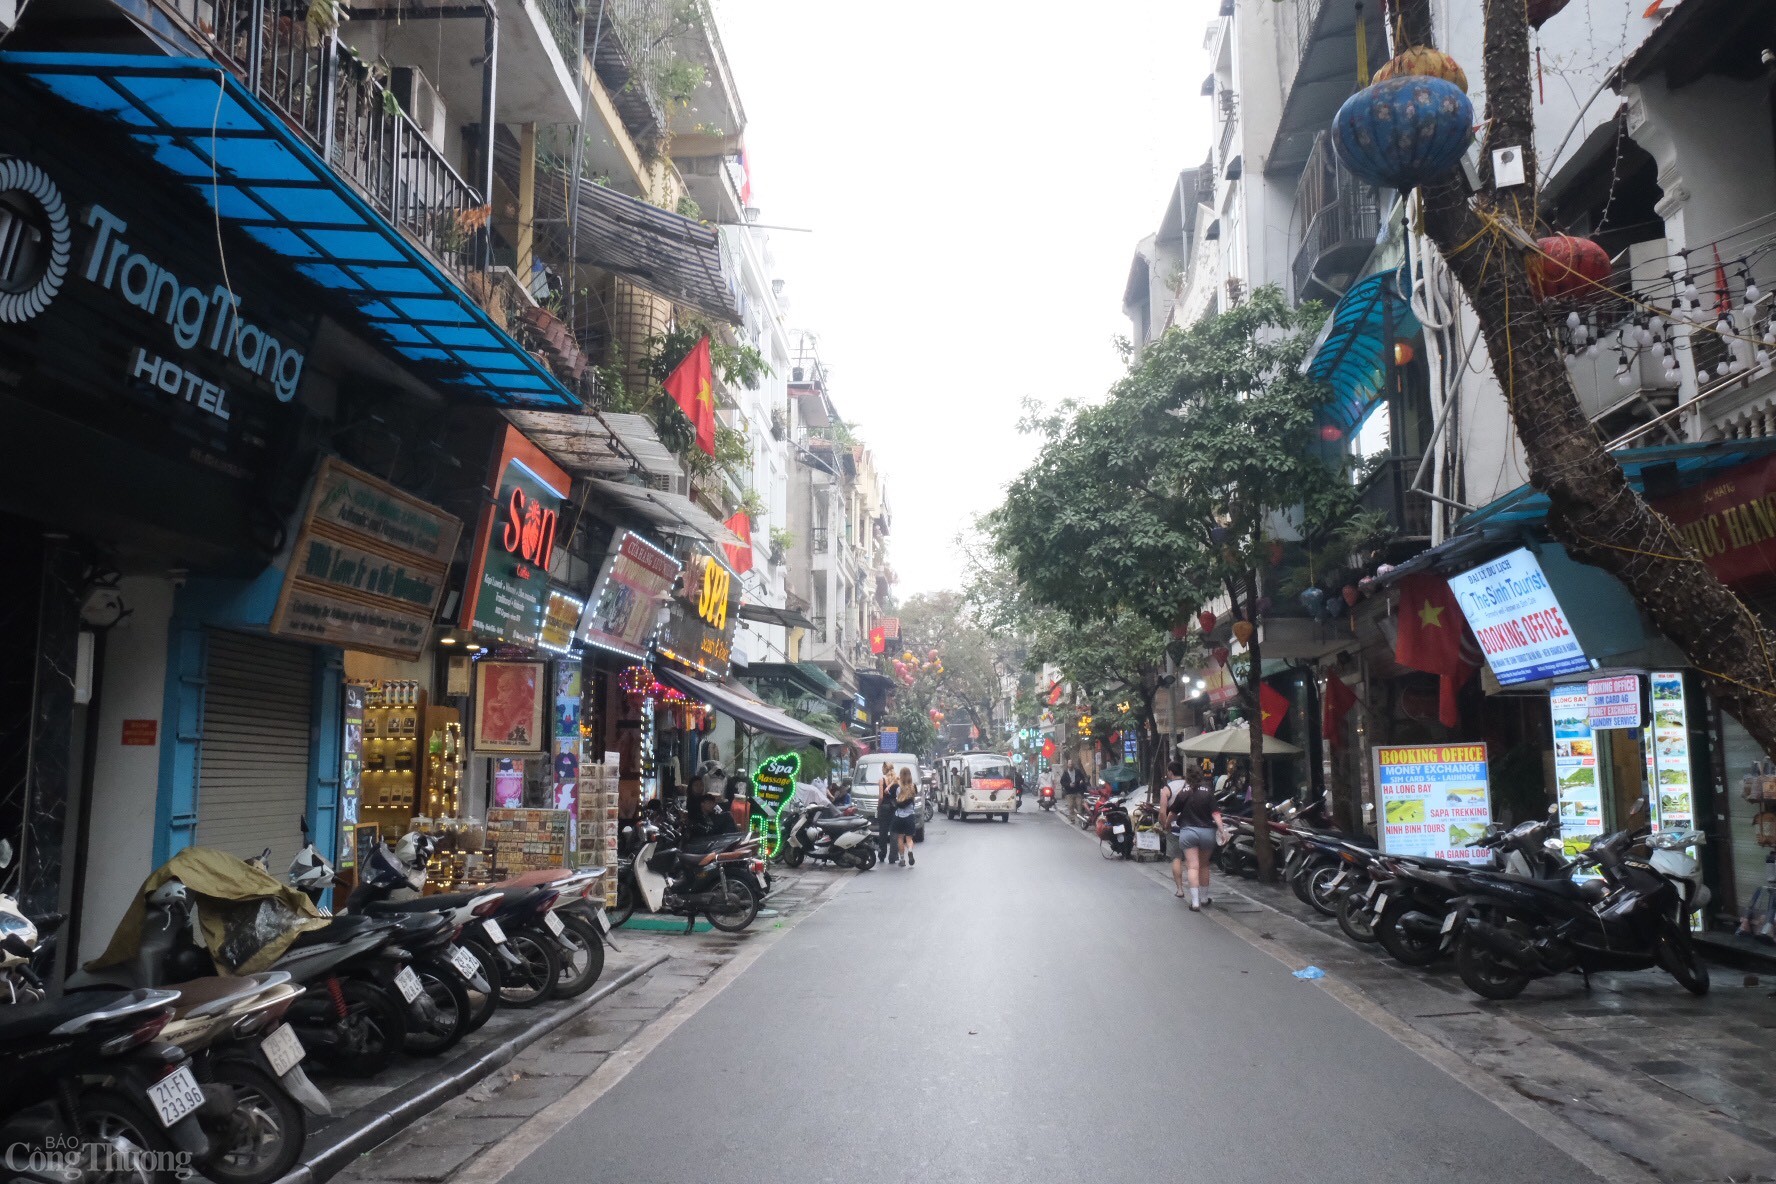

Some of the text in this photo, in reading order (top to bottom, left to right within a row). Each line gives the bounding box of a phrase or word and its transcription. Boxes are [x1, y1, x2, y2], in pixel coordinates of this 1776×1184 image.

[133, 347, 231, 421] HOTEL
[699, 556, 730, 630] SPA
[1477, 606, 1569, 655] BOOKING OFFICE
[1613, 678, 1637, 692] OFFICE
[1594, 696, 1606, 706] SIM
[1606, 695, 1620, 705] CARD
[1621, 694, 1630, 703] 4G
[1589, 704, 1637, 717] MONEY EXCHANGE
[1590, 715, 1637, 728] LAUNDRY SERVICE
[1381, 746, 1484, 765] BOOKING OFFICE
[768, 760, 794, 775] Spa
[1385, 763, 1481, 776] MONEY EXCHANGE
[758, 773, 791, 786] Massage
[1390, 775, 1405, 784] SIM
[1405, 774, 1424, 784] CARD
[1425, 774, 1437, 783] 5G
[1442, 772, 1477, 782] LAUNDRY
[1383, 783, 1432, 795] HA LONG BAY
[1430, 808, 1488, 818] SAPA TREKKING
[1386, 824, 1446, 835] NINH BINH TOURS
[1434, 848, 1491, 859] HA GIANG LOOP
[157, 1073, 191, 1104] 21-F1
[162, 1087, 203, 1124] 233.96
